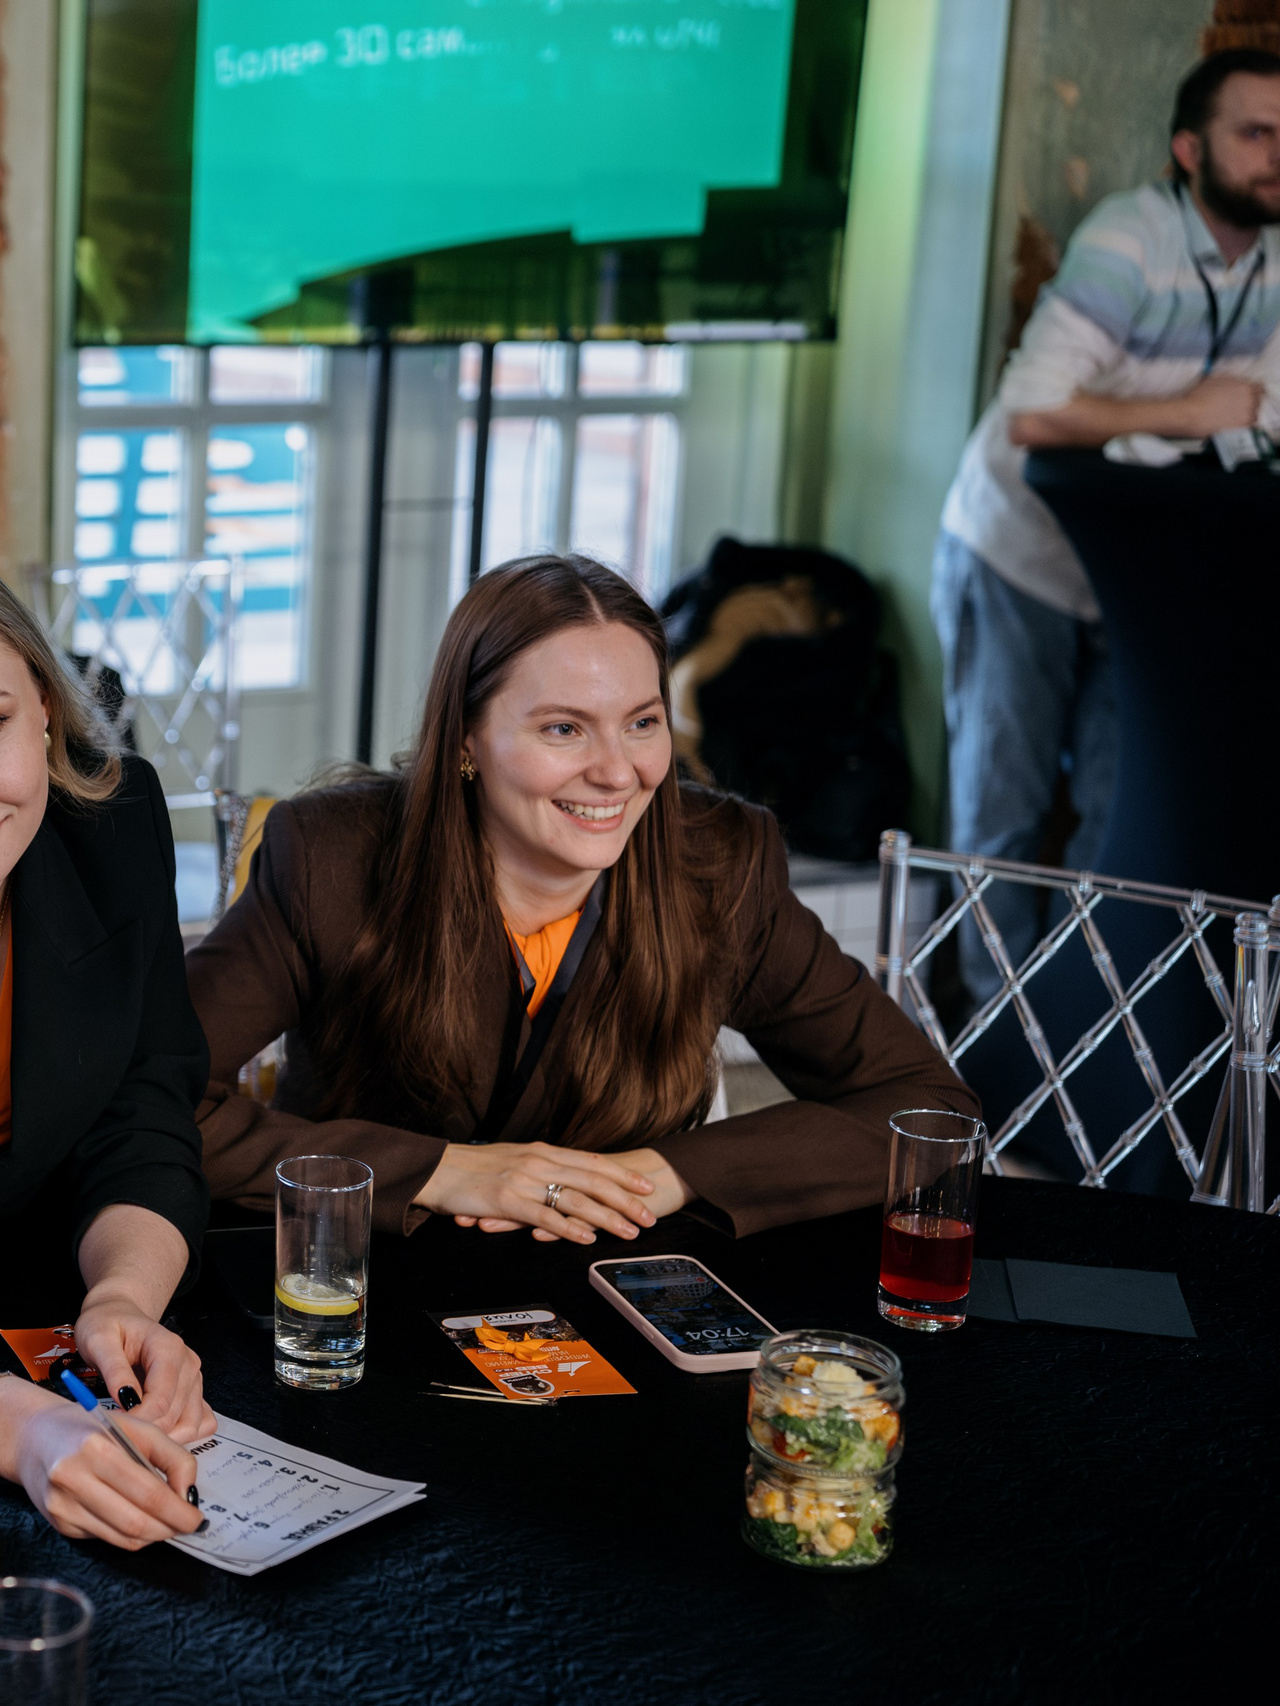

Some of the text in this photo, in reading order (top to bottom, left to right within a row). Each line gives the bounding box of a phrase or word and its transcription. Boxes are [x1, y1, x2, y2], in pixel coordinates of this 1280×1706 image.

[214, 41, 328, 88] Более
[334, 24, 390, 67] 30
[685, 1327, 749, 1341] 17:04
[231, 1451, 253, 1461] 5.
[254, 1458, 273, 1468] 4.
[275, 1466, 296, 1477] 3.
[297, 1474, 318, 1484] 2.
[321, 1484, 340, 1493] 1.
[205, 1504, 227, 1513] 8.
[227, 1512, 250, 1522] 7.
[249, 1521, 270, 1531] 6.
